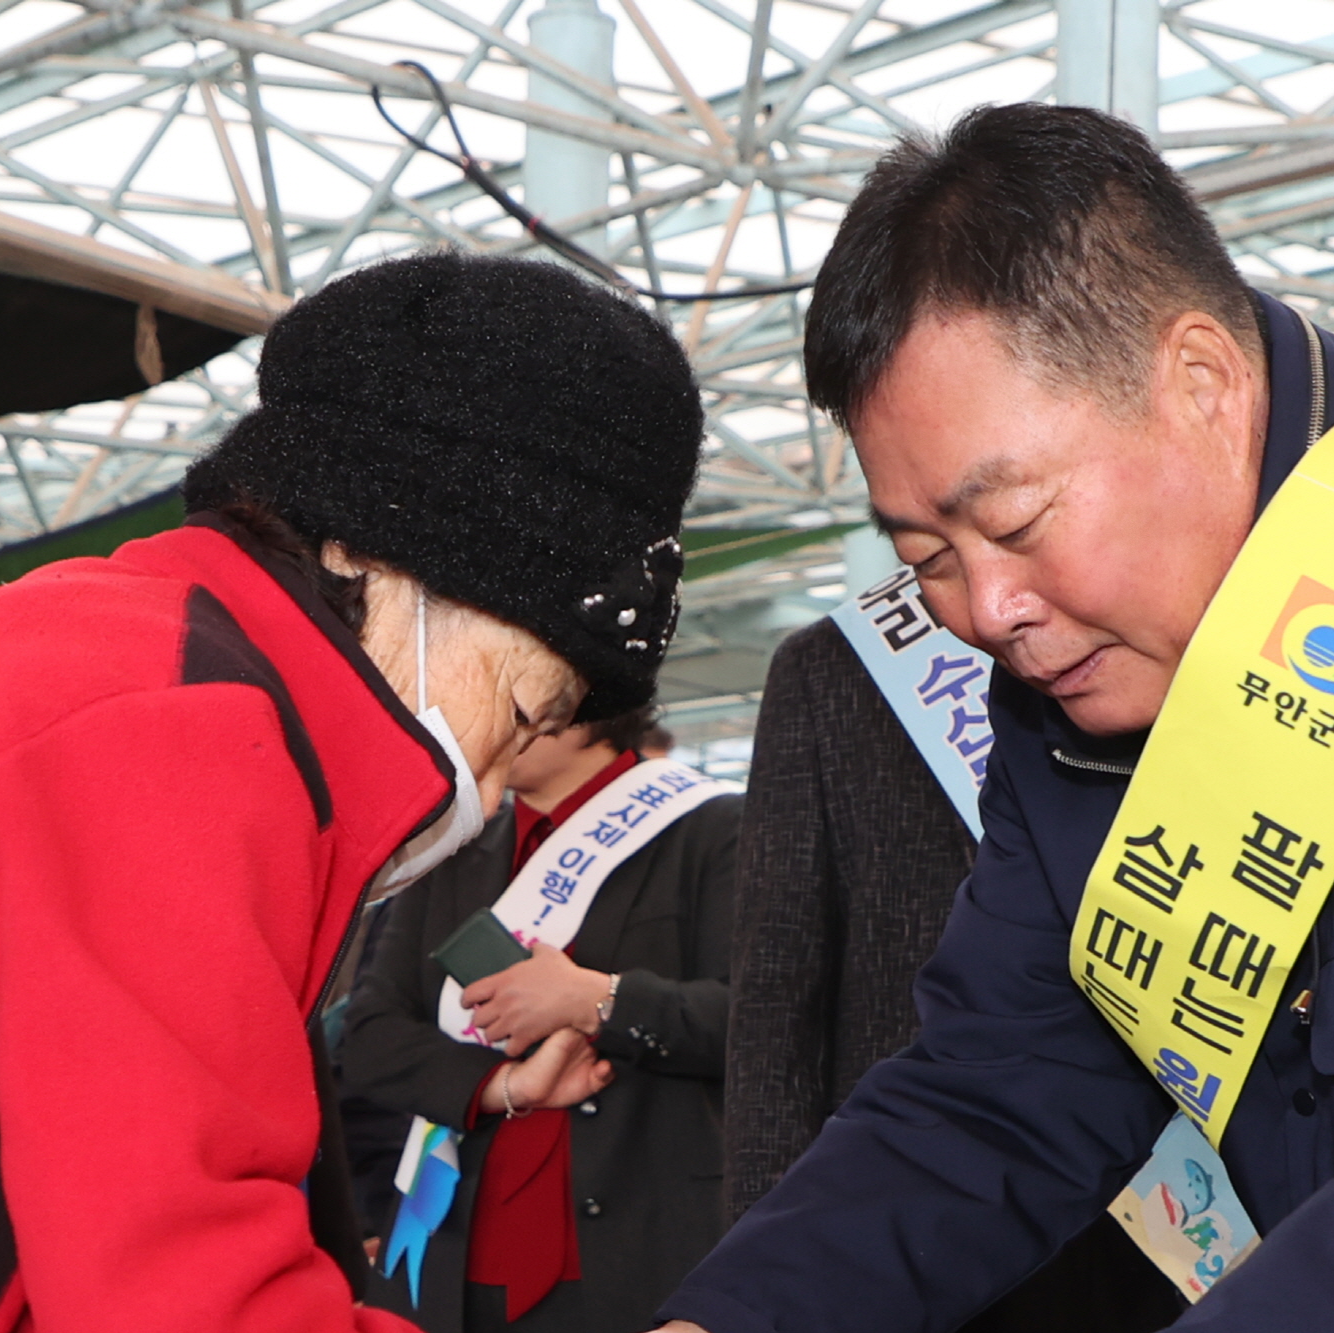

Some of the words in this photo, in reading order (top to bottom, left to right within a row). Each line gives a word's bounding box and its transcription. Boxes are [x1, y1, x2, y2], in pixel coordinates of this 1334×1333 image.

[533, 848, 597, 926] 이행!
[1113, 825, 1205, 915] 살
[1231, 811, 1324, 912] 팔
[1171, 911, 1276, 1055] 때는
